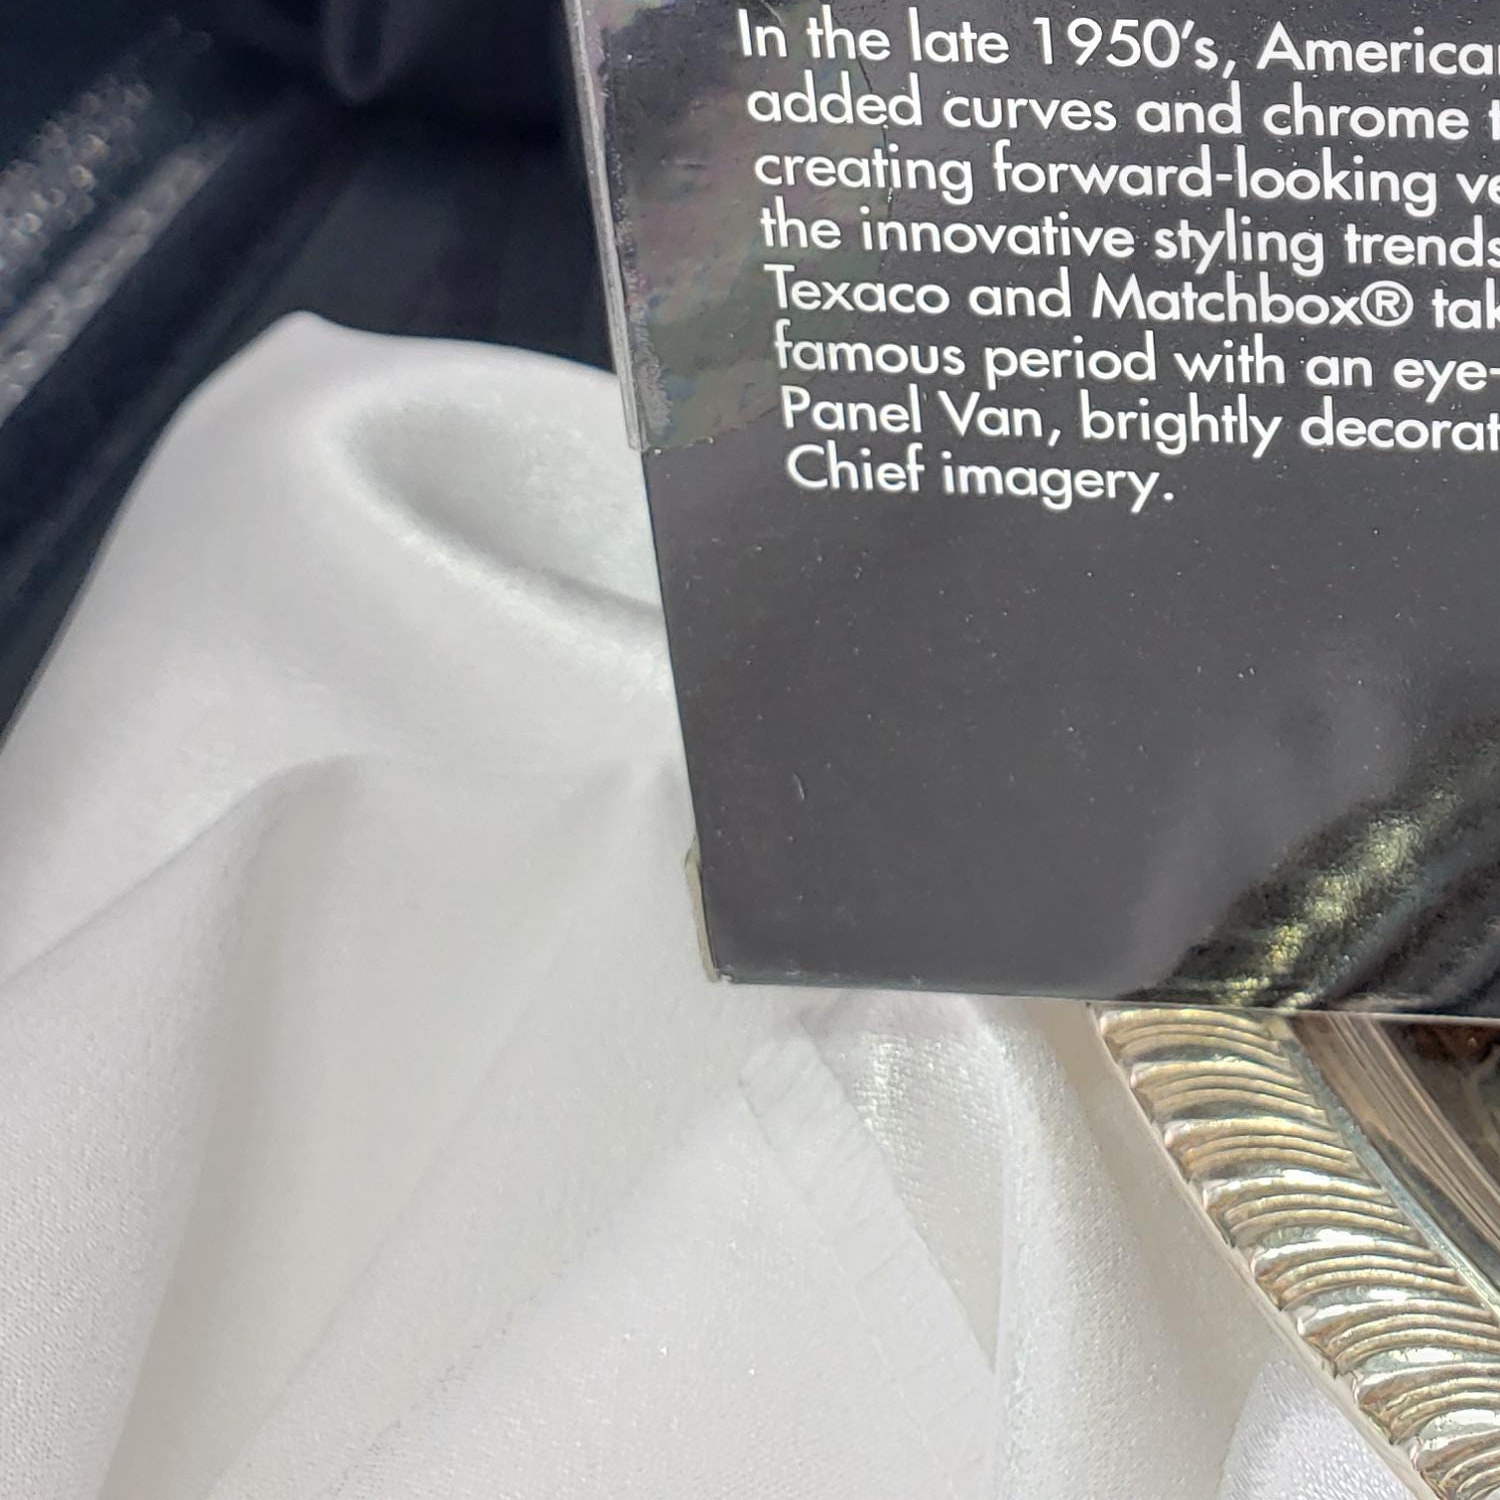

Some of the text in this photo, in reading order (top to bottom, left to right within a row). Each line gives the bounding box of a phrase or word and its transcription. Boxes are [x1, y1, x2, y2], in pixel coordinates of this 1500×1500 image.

[735, 5, 790, 61] In
[804, 3, 892, 62] the
[907, 5, 1011, 66] late
[745, 68, 924, 128] added
[941, 95, 1118, 133] curves
[1135, 78, 1243, 136] and
[1262, 80, 1471, 142] chrome
[753, 141, 975, 207] creating
[991, 137, 1439, 219] forward-looking
[758, 194, 843, 251] the
[858, 204, 1136, 260] innovative
[1153, 206, 1325, 279] styling
[762, 262, 951, 316] Texaco
[967, 264, 1073, 319] and
[772, 317, 967, 377] famous
[983, 328, 1158, 392] period
[1172, 331, 1287, 386] with
[1304, 354, 1374, 388] an
[780, 382, 923, 435] Panel
[936, 389, 1063, 448] Van,
[1078, 387, 1284, 460] brightly
[785, 438, 1177, 515] Chief imagery.
